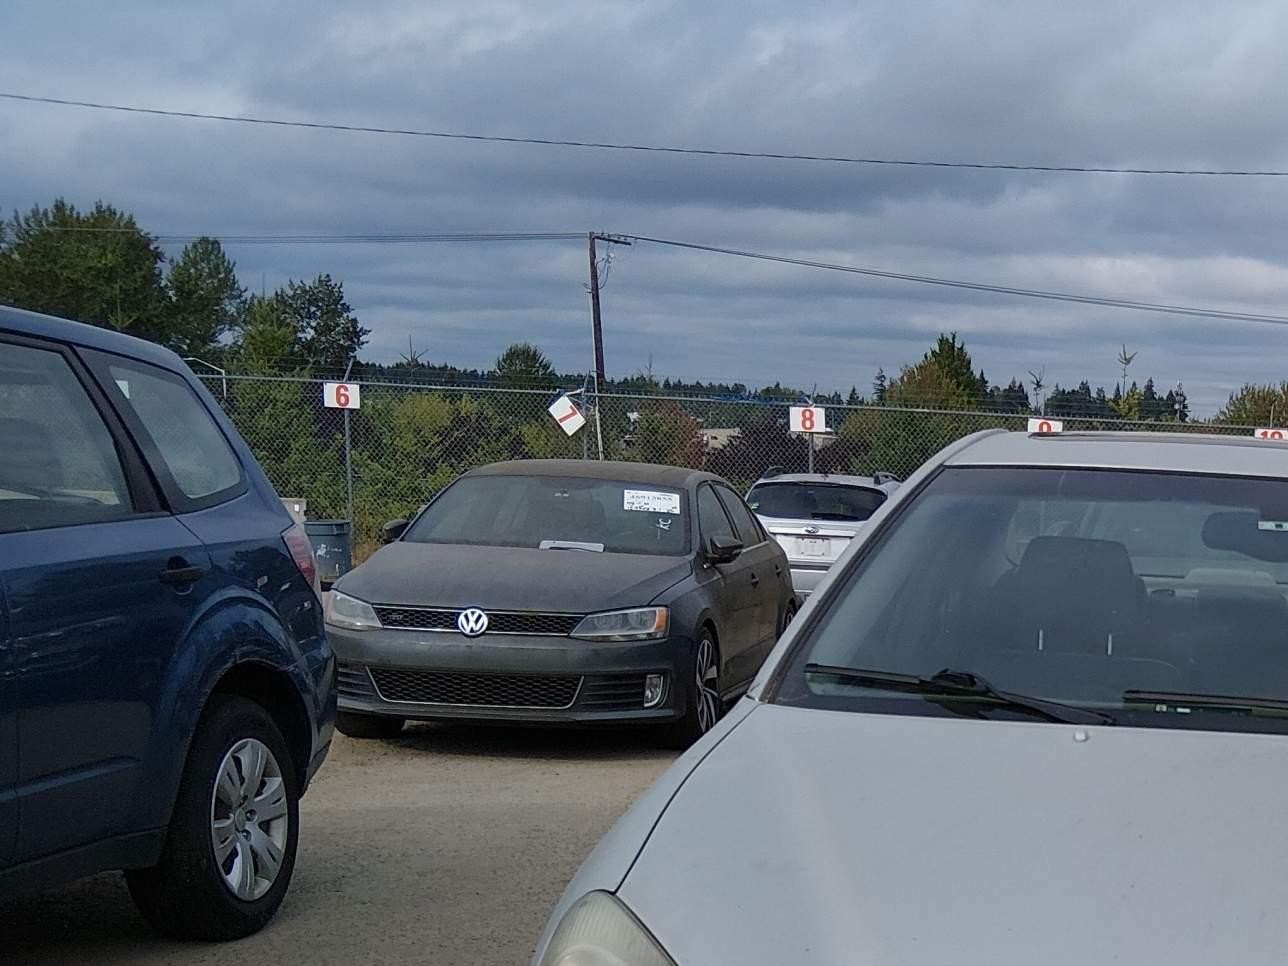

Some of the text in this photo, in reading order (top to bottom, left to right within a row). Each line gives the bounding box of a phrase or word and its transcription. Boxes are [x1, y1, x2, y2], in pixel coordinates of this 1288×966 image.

[336, 384, 349, 407] 6
[558, 404, 578, 423] 7
[801, 409, 815, 431] 8
[458, 608, 489, 636] VW
